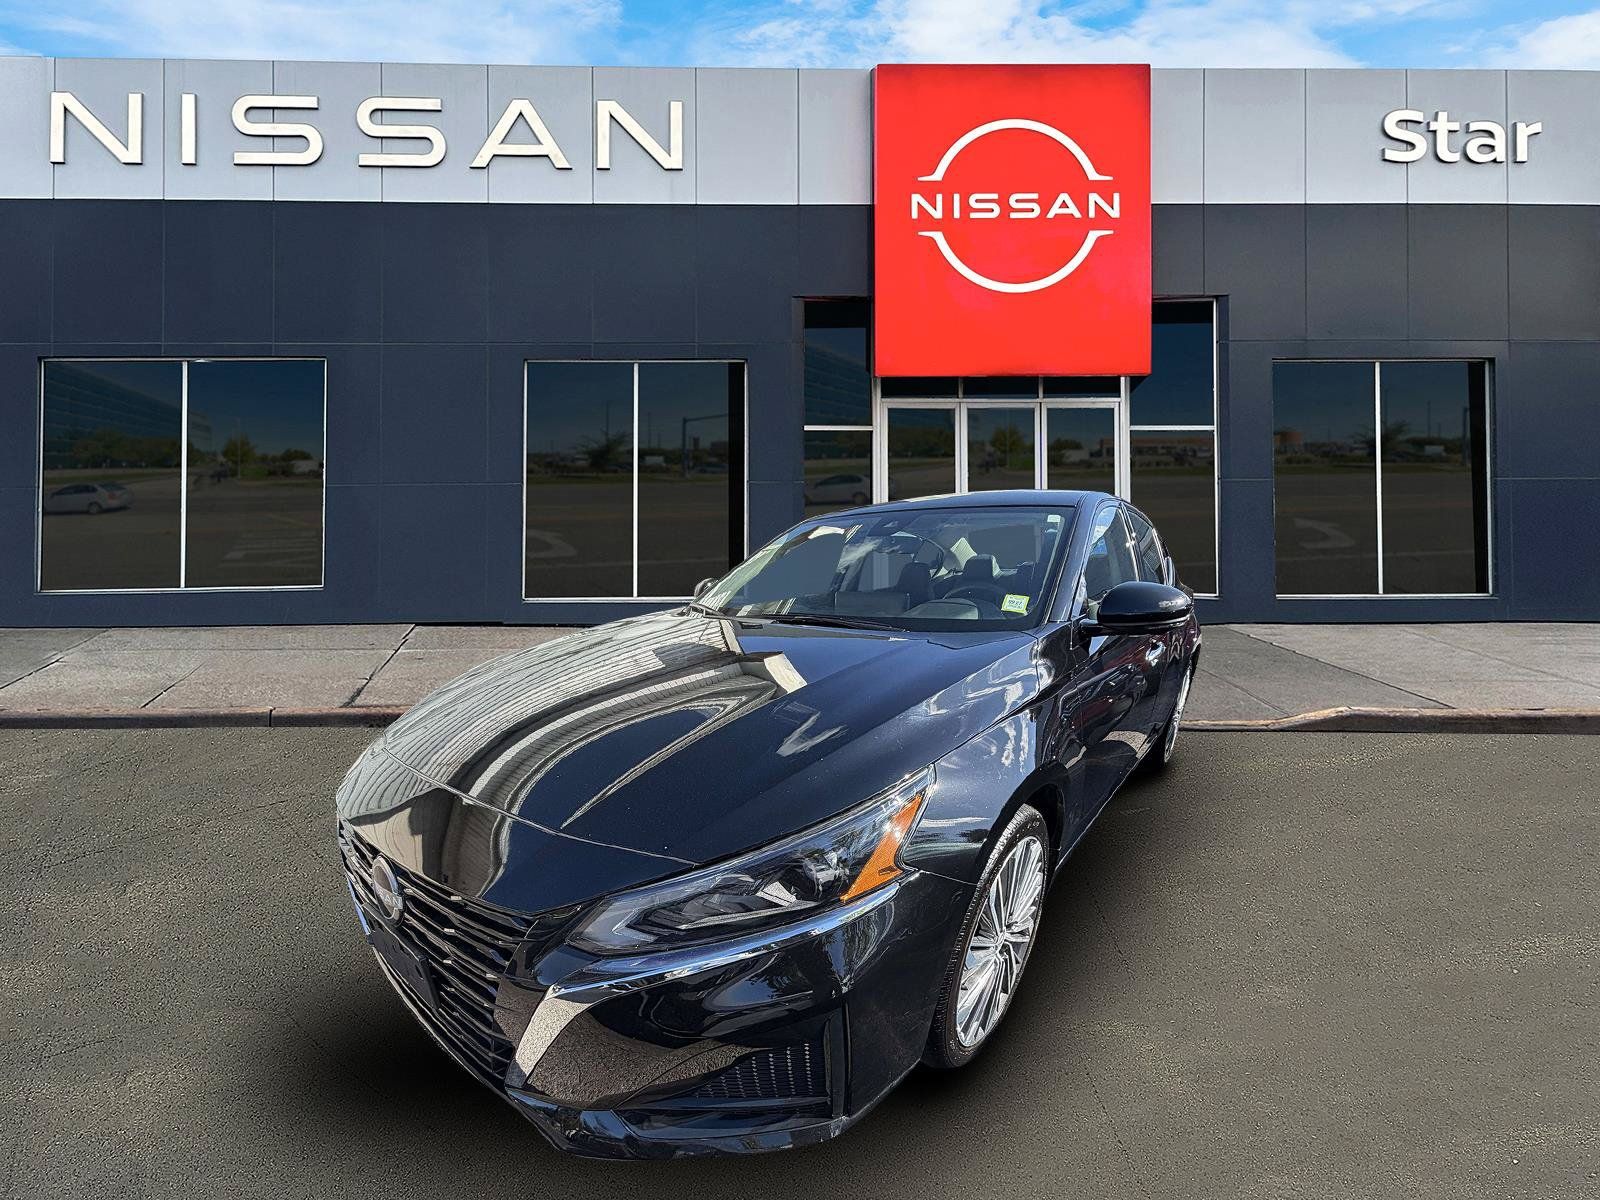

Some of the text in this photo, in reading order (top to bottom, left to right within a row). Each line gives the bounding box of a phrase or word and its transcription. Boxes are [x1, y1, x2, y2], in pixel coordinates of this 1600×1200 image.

[50, 91, 684, 170] NISSAN
[1382, 109, 1543, 164] Star
[911, 191, 1121, 219] NISSAN
